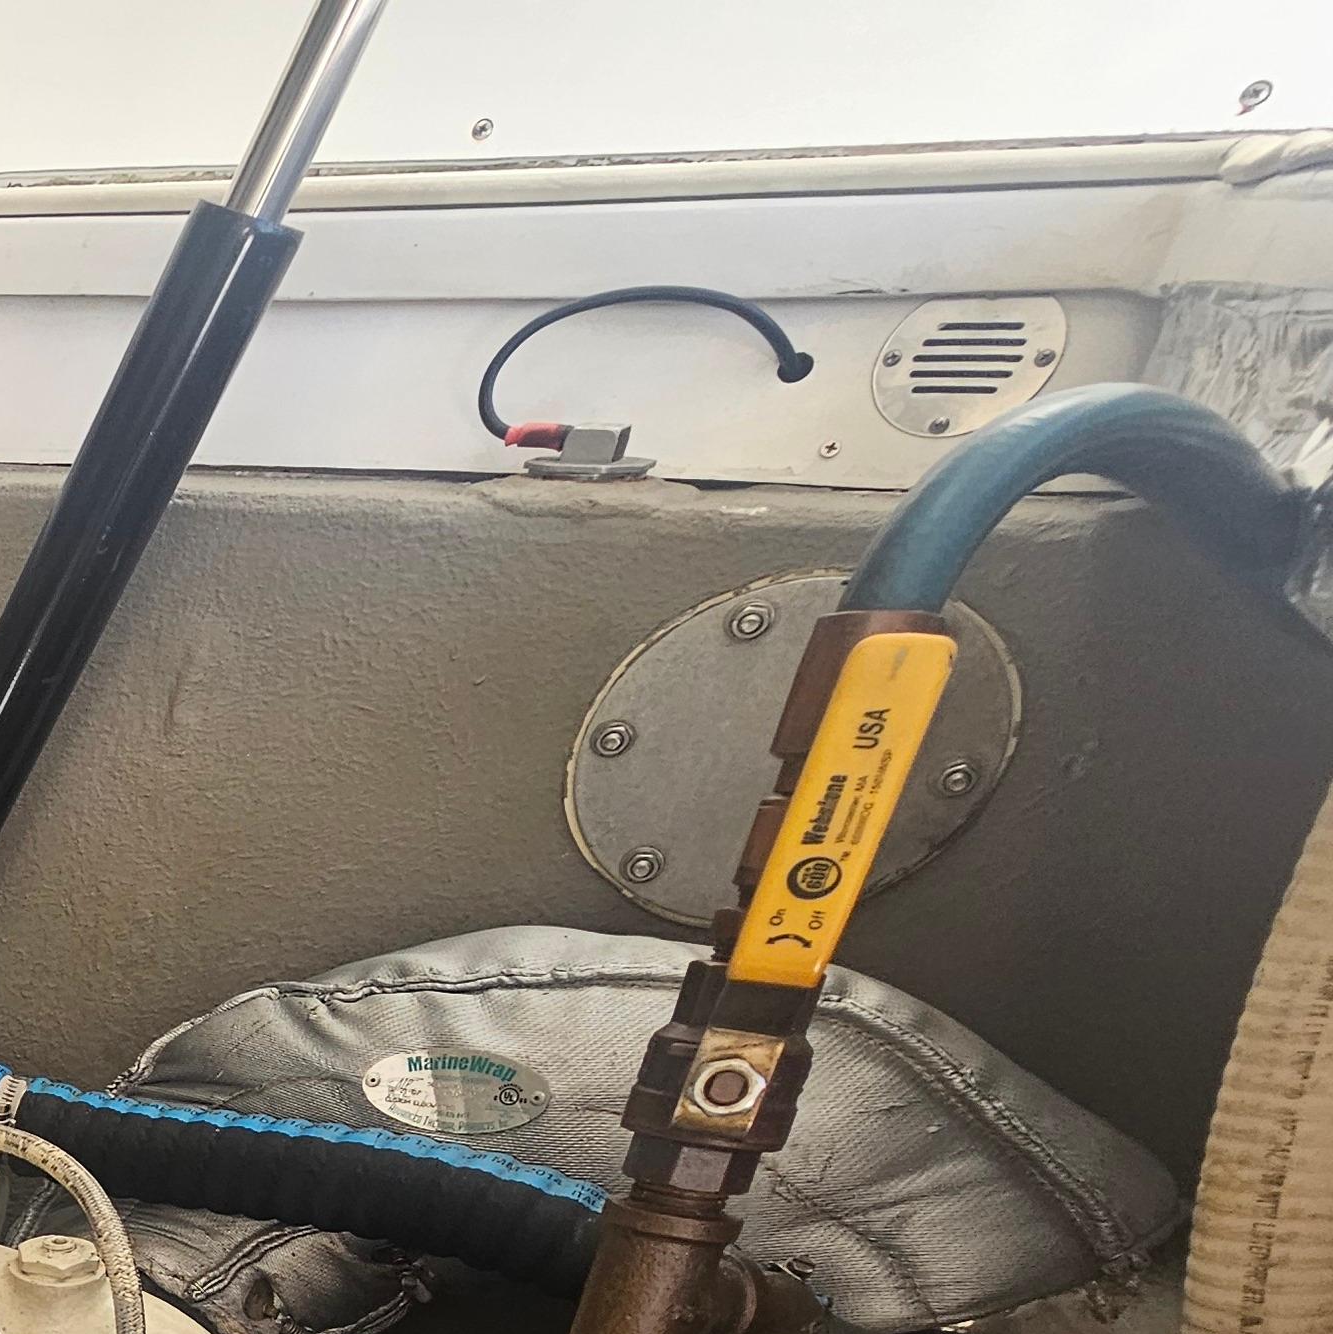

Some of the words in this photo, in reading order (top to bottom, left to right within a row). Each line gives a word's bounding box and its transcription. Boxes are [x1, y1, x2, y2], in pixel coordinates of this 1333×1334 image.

[852, 708, 891, 750] USA
[769, 908, 787, 927] On
[808, 910, 826, 931] Off
[407, 1054, 518, 1083] MarineWrap
